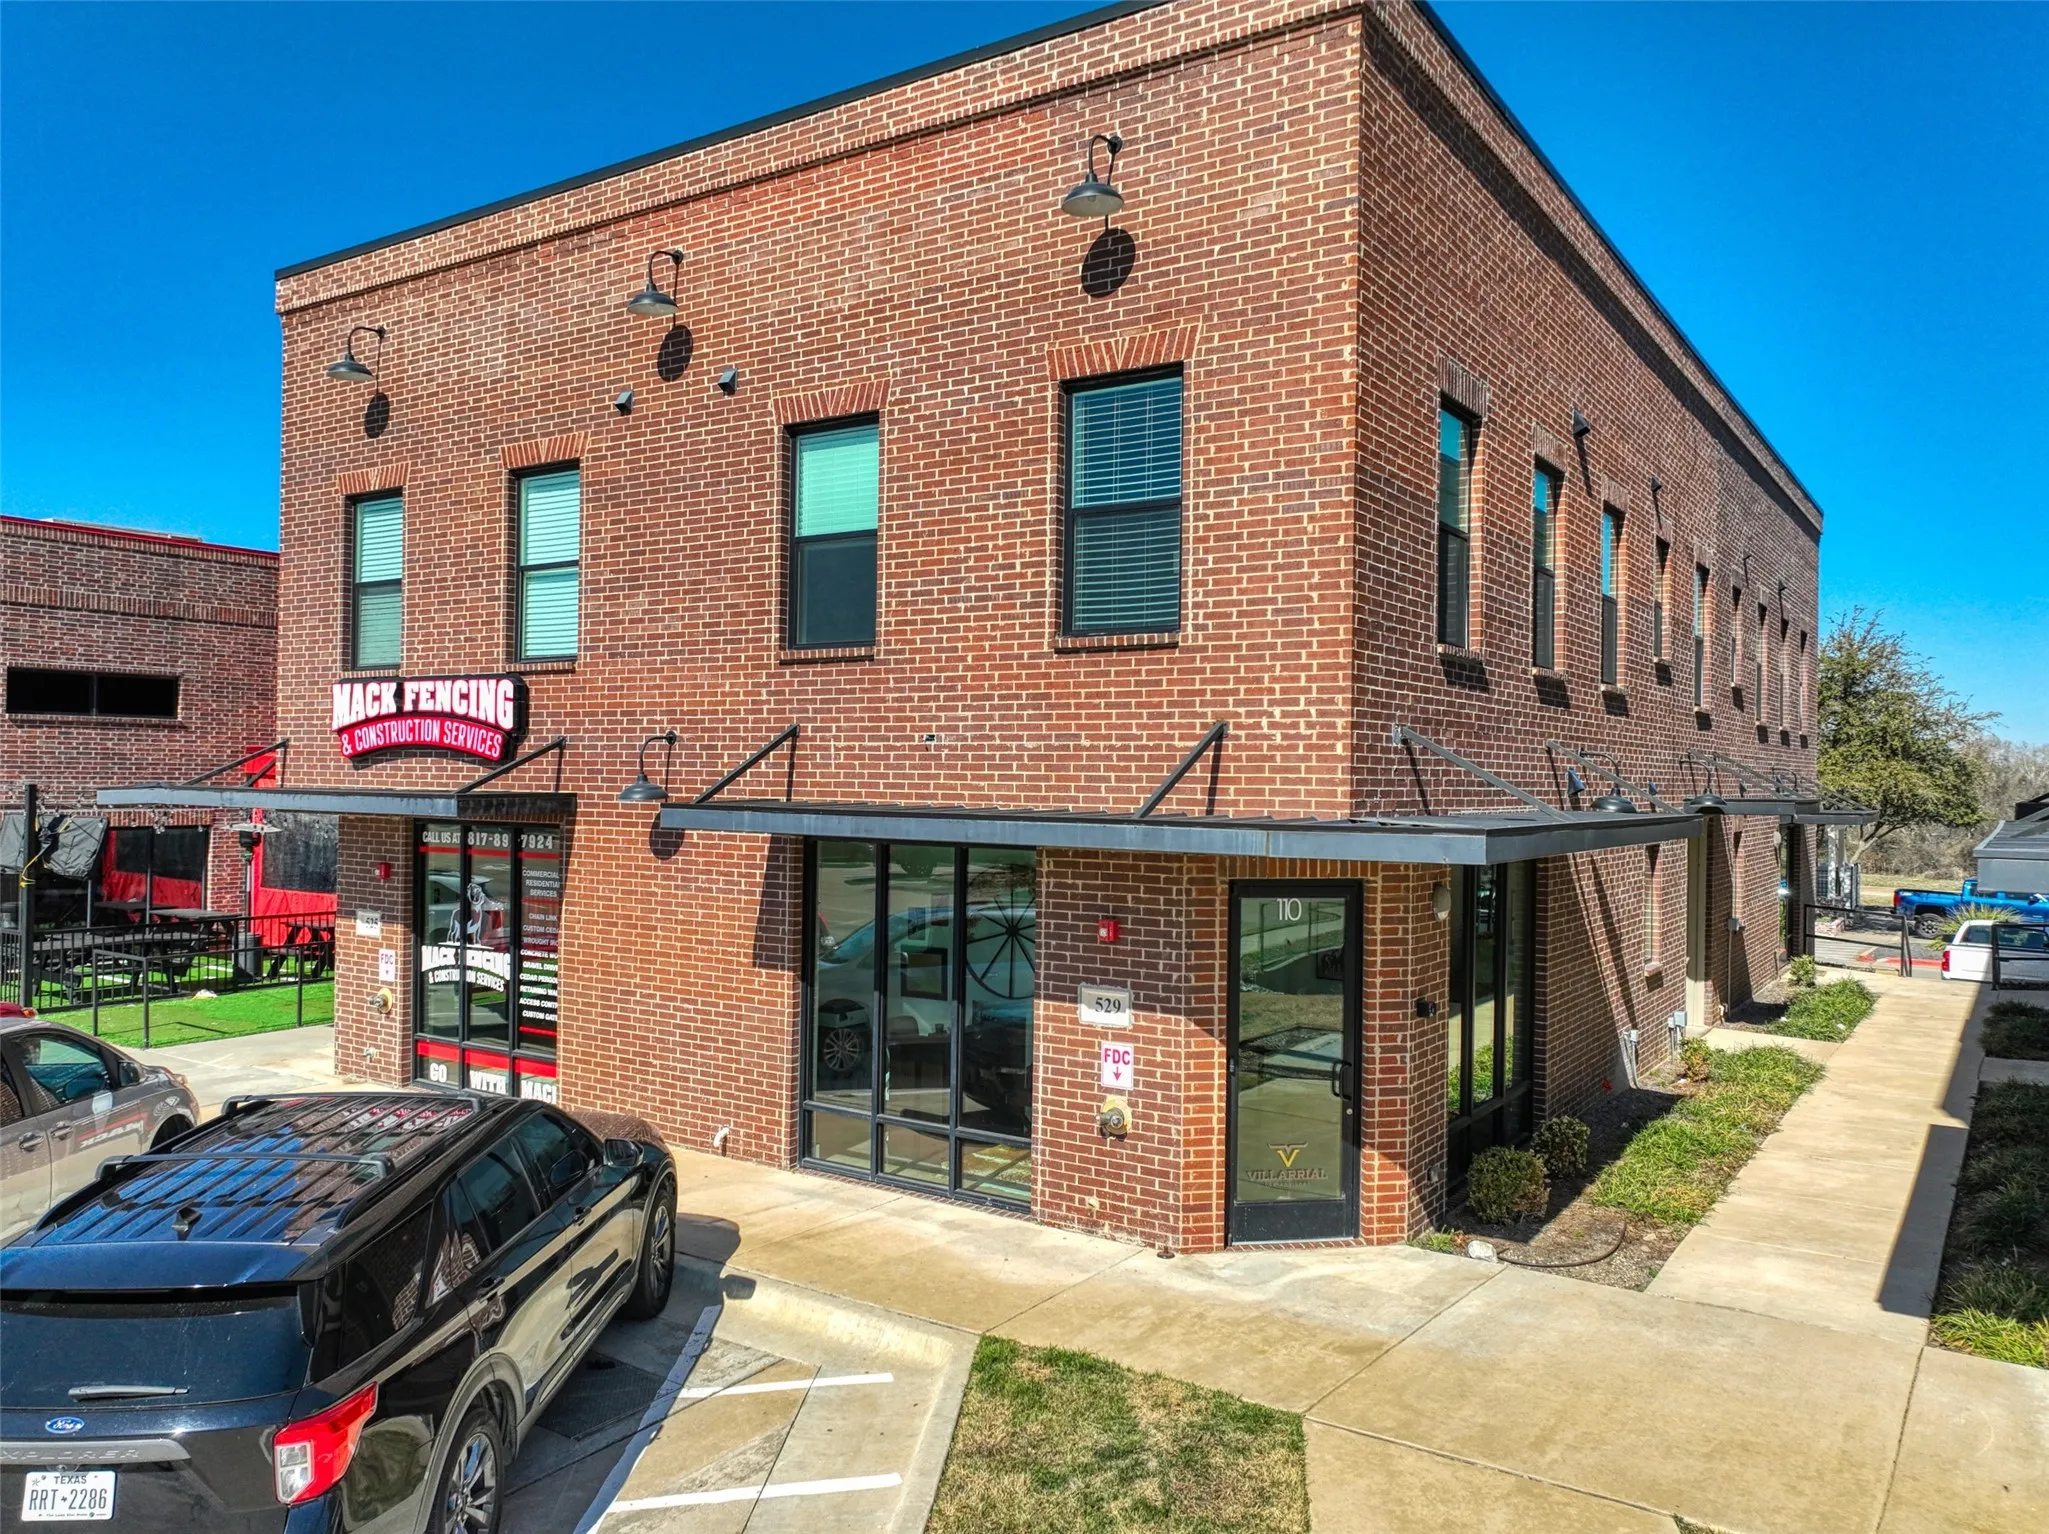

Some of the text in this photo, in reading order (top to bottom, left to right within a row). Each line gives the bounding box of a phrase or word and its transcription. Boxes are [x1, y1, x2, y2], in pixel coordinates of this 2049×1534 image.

[332, 679, 514, 731] MACK FENCING
[341, 719, 502, 758] & CONSTRUCTION SERVICES
[422, 831, 461, 844] CALL US AT
[522, 869, 559, 878] COMMERCIAL
[529, 888, 557, 898] SERVICES
[1276, 898, 1302, 921] 110
[528, 912, 558, 921] CHAIN LINK
[522, 924, 544, 933] CUSTOM
[380, 953, 394, 965] FDC
[421, 945, 456, 972] MACK
[476, 972, 505, 993] SERVICES
[519, 997, 540, 1007] ACCESS
[1094, 997, 1122, 1014] 529
[522, 1009, 545, 1020] CUSTOM
[1103, 1047, 1131, 1066] FDC
[429, 1062, 448, 1083] GO
[469, 1070, 506, 1095] WITH
[1245, 1168, 1328, 1182] VILLARRIAL
[53, 1475, 87, 1485] TEXAS
